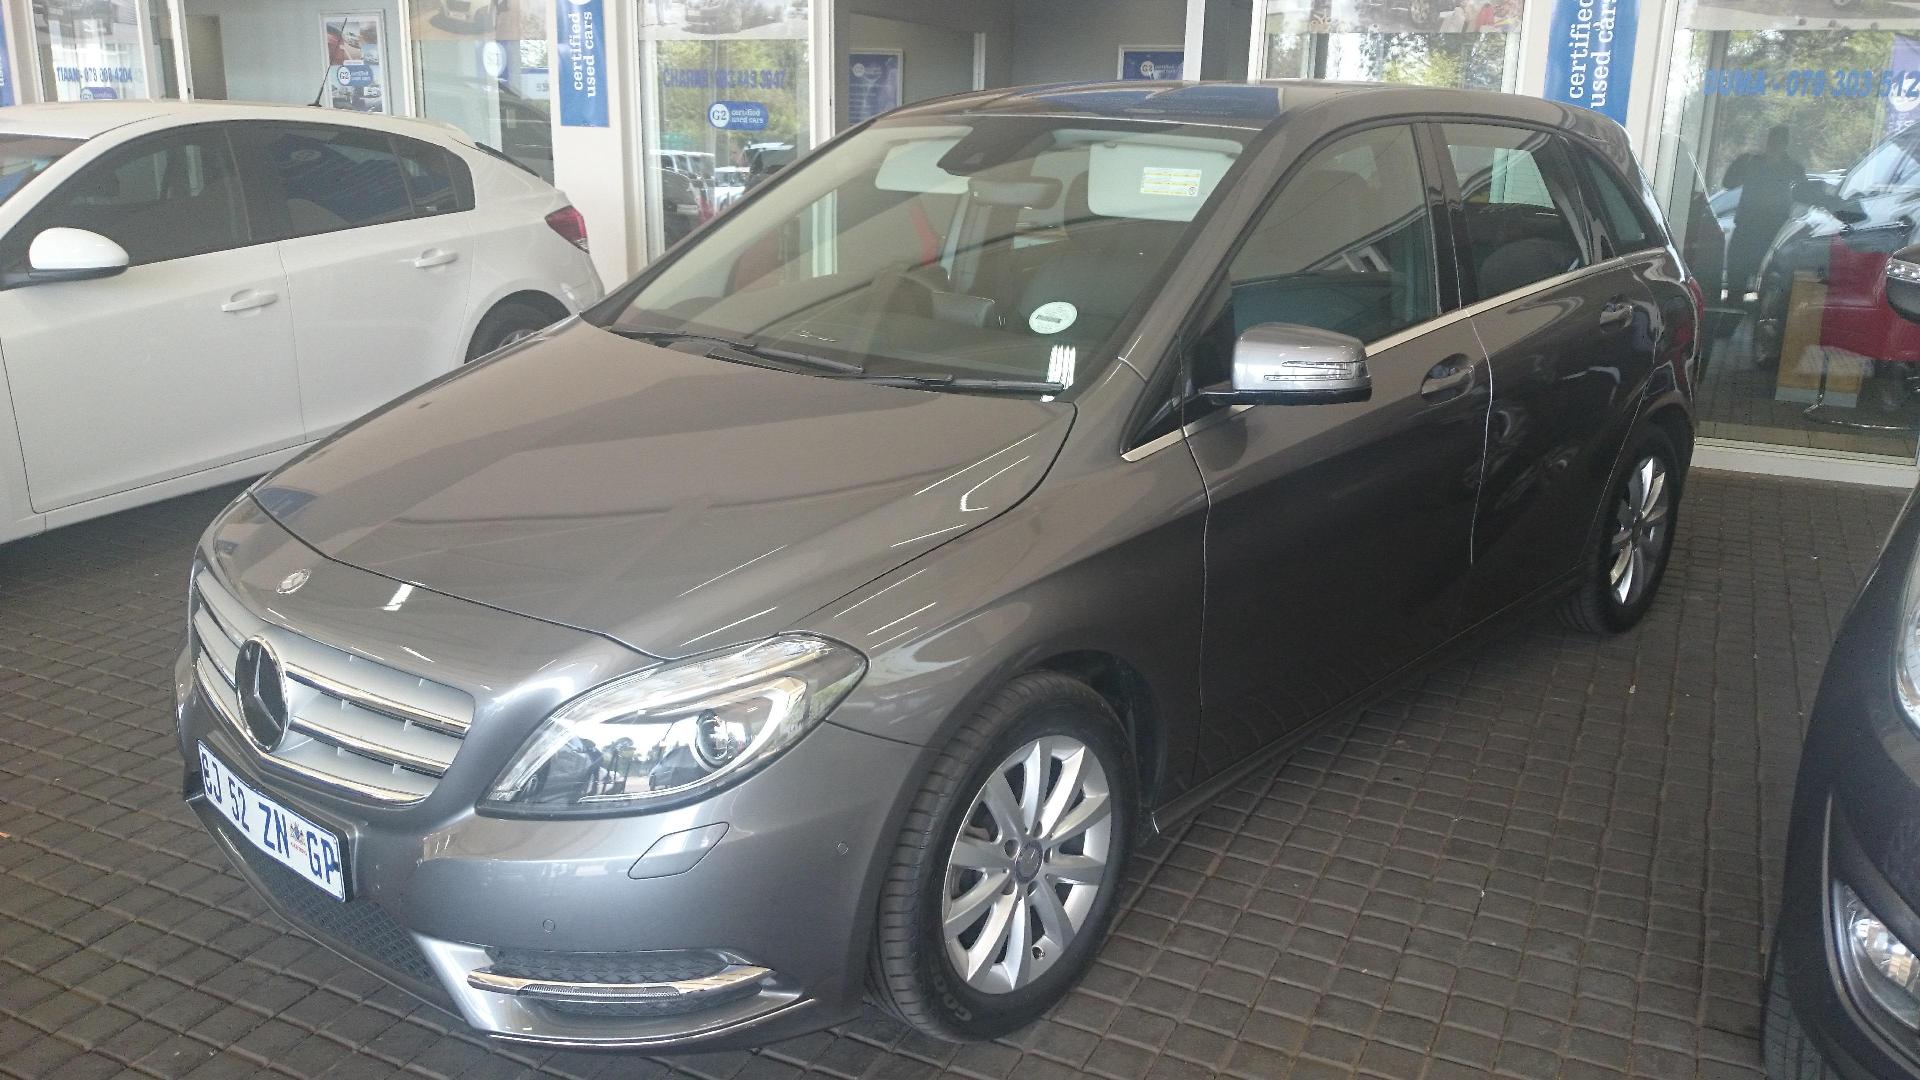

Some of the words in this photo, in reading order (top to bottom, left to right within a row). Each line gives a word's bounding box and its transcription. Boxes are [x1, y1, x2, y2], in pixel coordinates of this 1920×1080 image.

[583, 11, 594, 49] cars
[1599, 0, 1617, 43] car
[568, 10, 583, 91] certified
[583, 54, 596, 97] used
[1590, 50, 1611, 109] used
[227, 775, 250, 832] 52
[258, 802, 290, 859] ZN
[306, 830, 340, 885] GP
